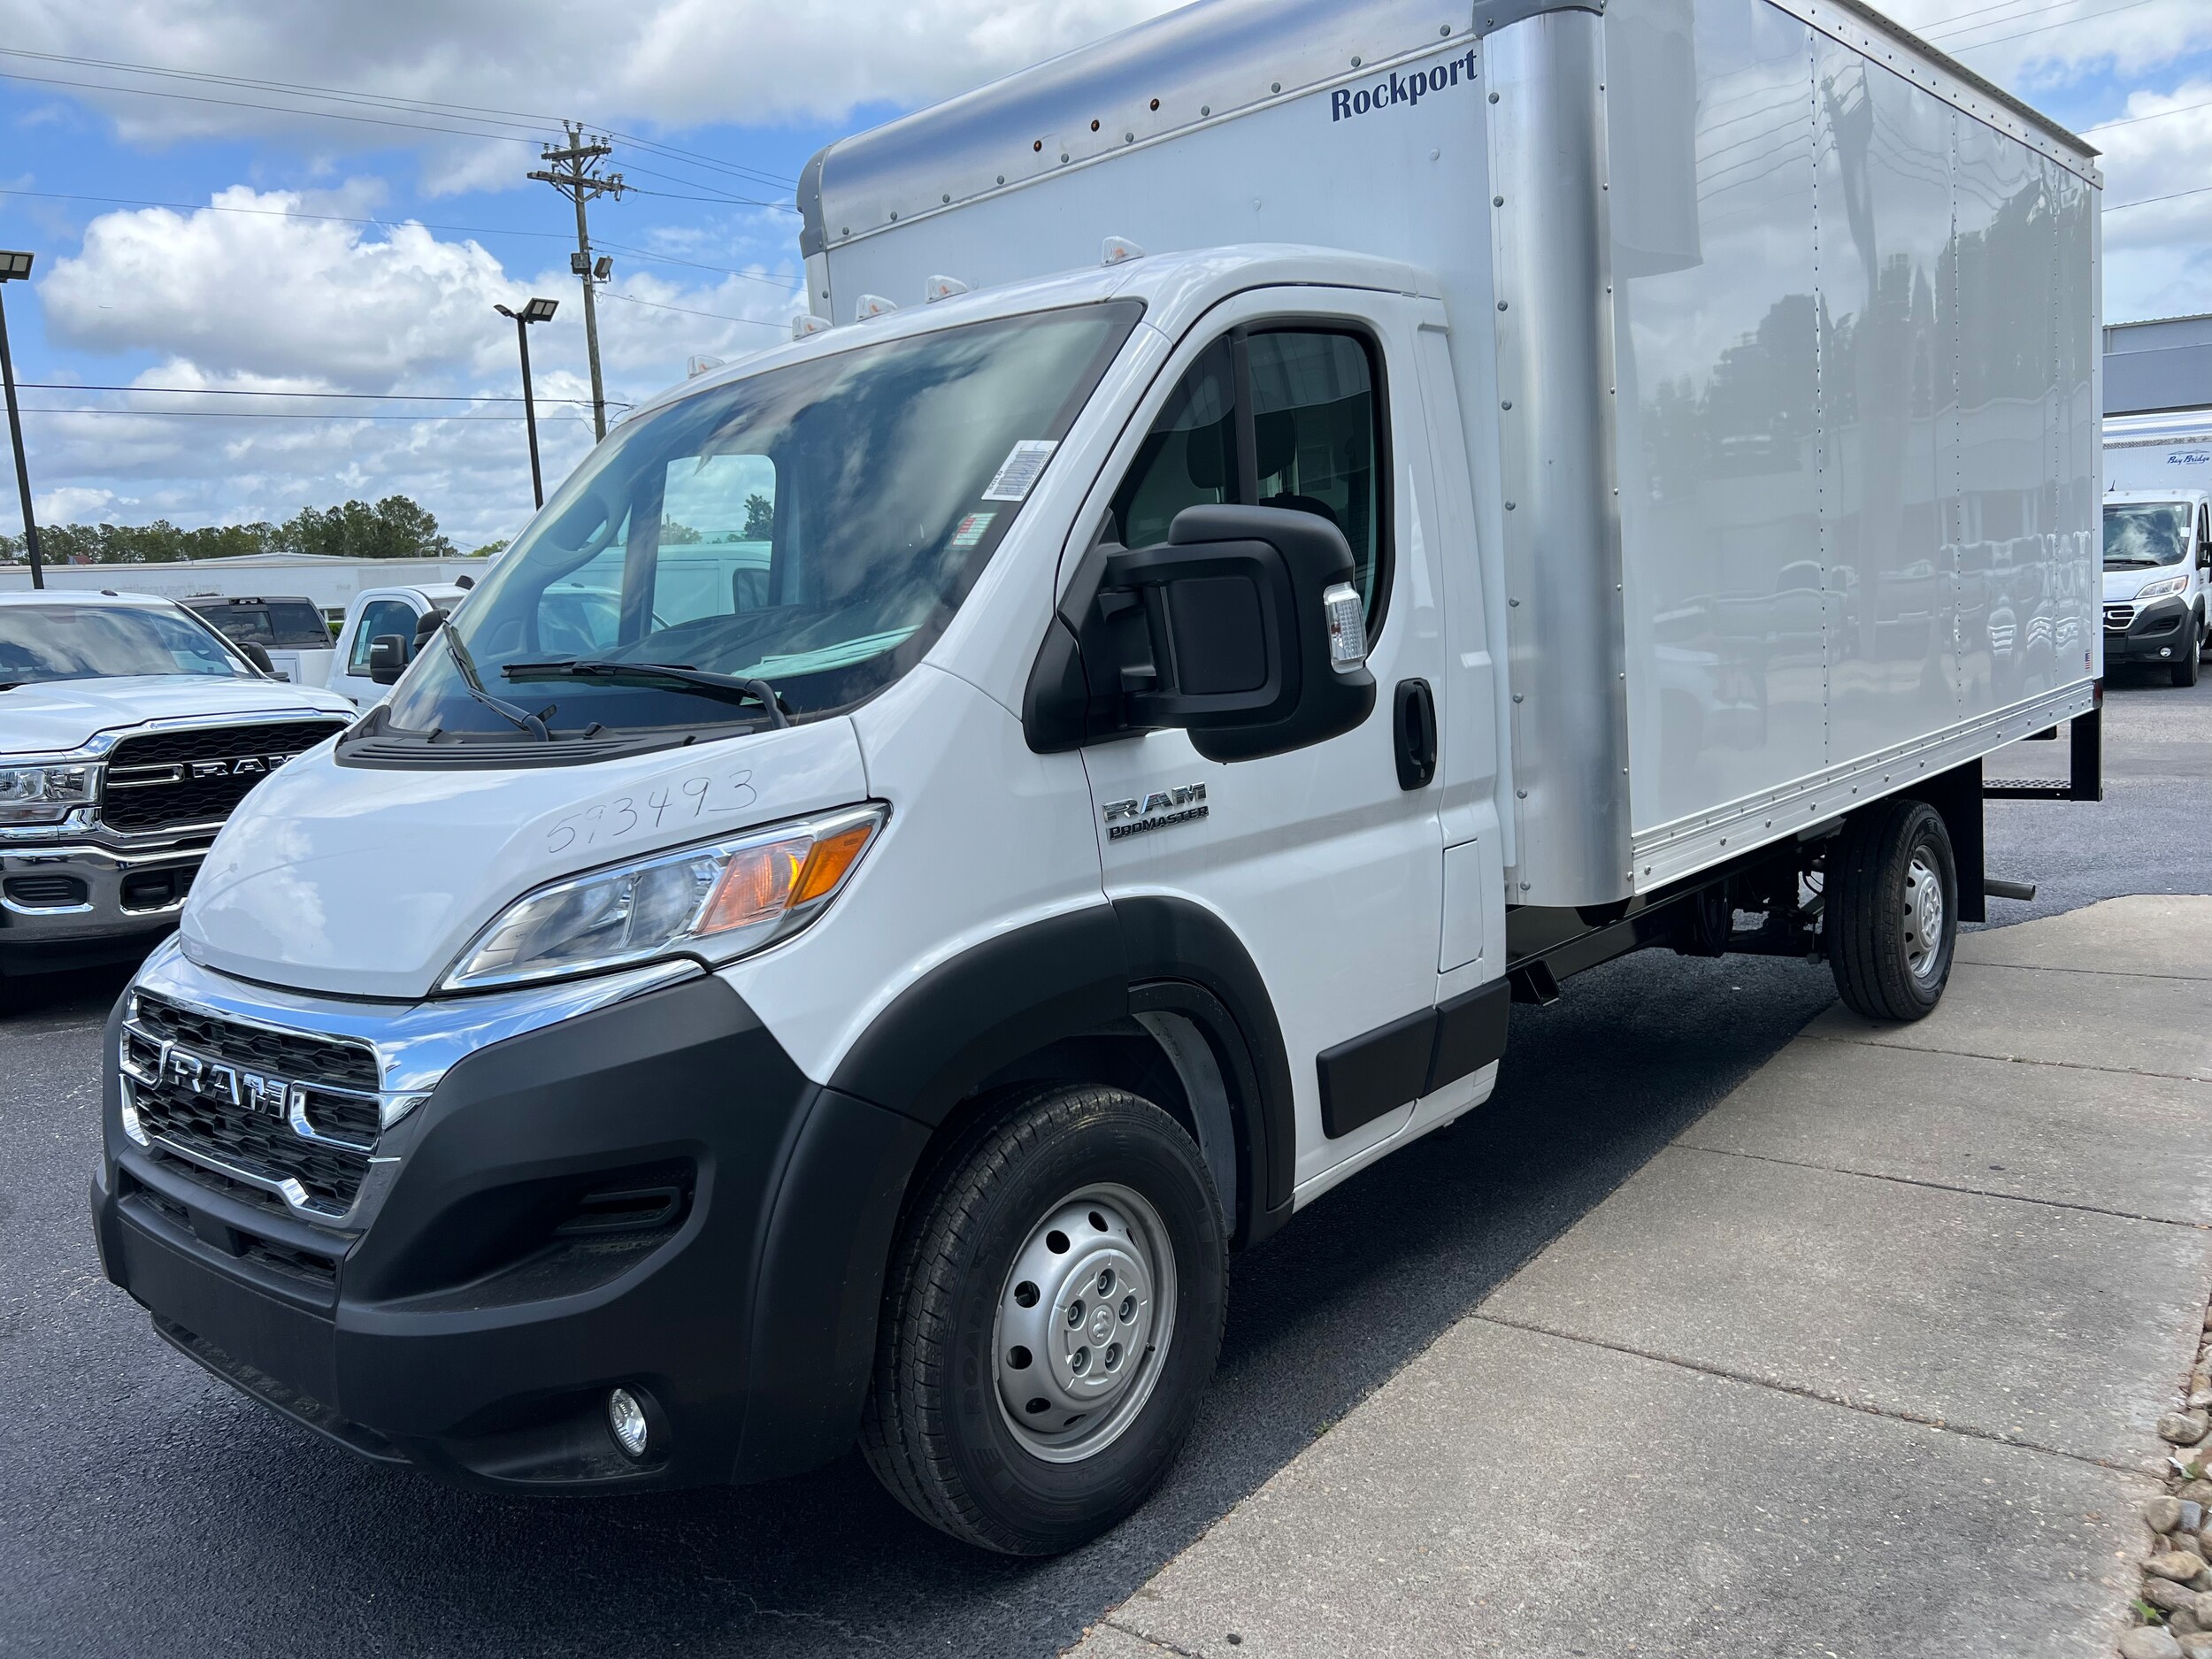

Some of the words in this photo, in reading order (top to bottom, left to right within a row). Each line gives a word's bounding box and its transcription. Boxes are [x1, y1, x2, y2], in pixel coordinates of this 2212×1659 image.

[1331, 49, 1478, 122] Rockport
[2167, 456, 2183, 465] Bay
[2183, 455, 2210, 465] Bridge
[547, 770, 757, 853] 593493
[1102, 781, 1207, 822] RAM
[167, 1050, 288, 1120] RAM
